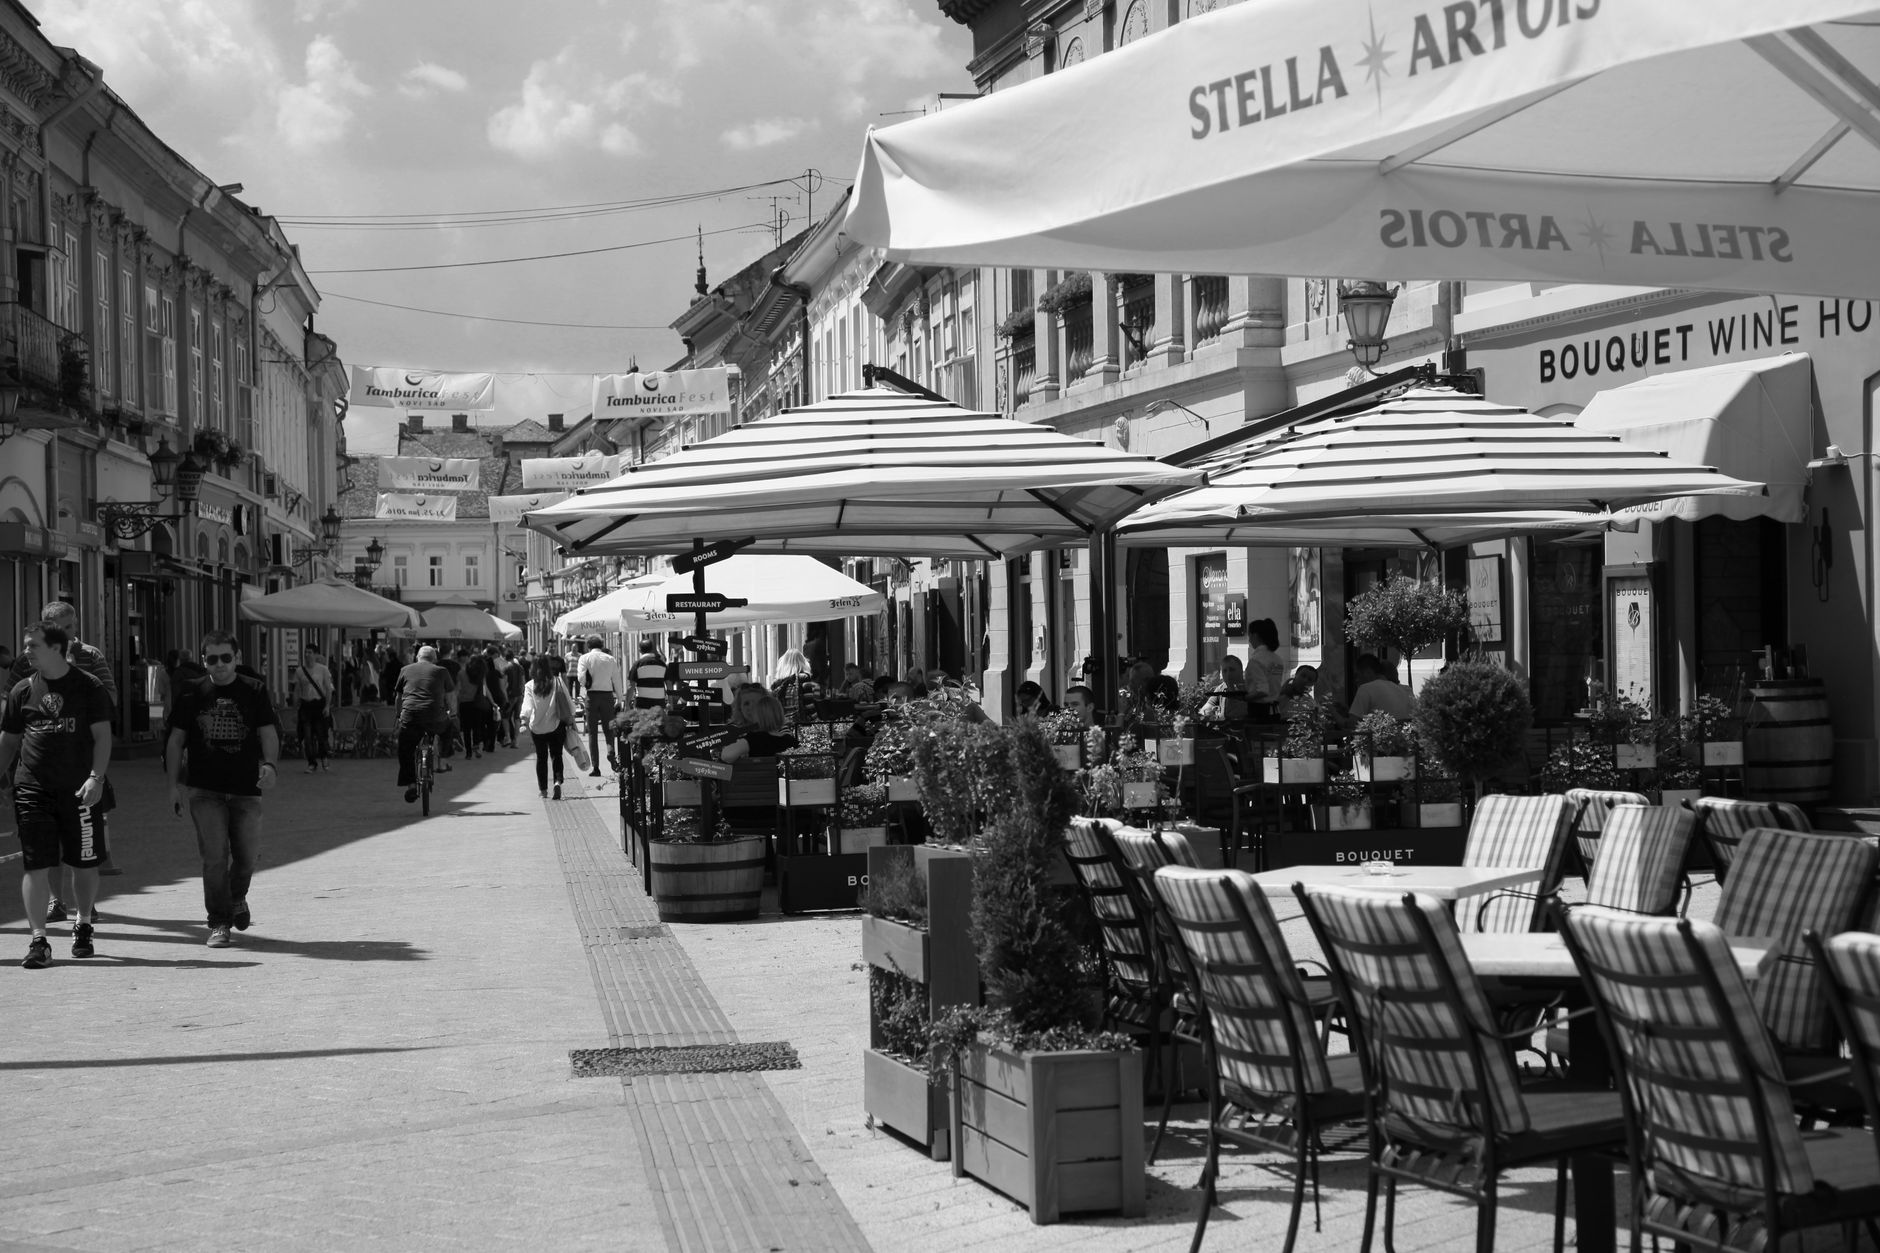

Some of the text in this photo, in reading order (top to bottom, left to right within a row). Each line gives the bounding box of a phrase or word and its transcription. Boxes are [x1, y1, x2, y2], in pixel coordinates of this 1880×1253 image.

[1188, 44, 1349, 140] STELLA
[1539, 323, 1694, 384] BOUQUET
[1707, 304, 1800, 357] WINE
[365, 384, 439, 399] Tamburica
[606, 390, 716, 407] Tamburica Fest
[692, 549, 718, 563] ROOMS
[1469, 600, 1498, 609] BOUQUET
[685, 667, 703, 675] WINE
[1335, 848, 1415, 863] BOUQUET
[847, 874, 869, 887] BO
